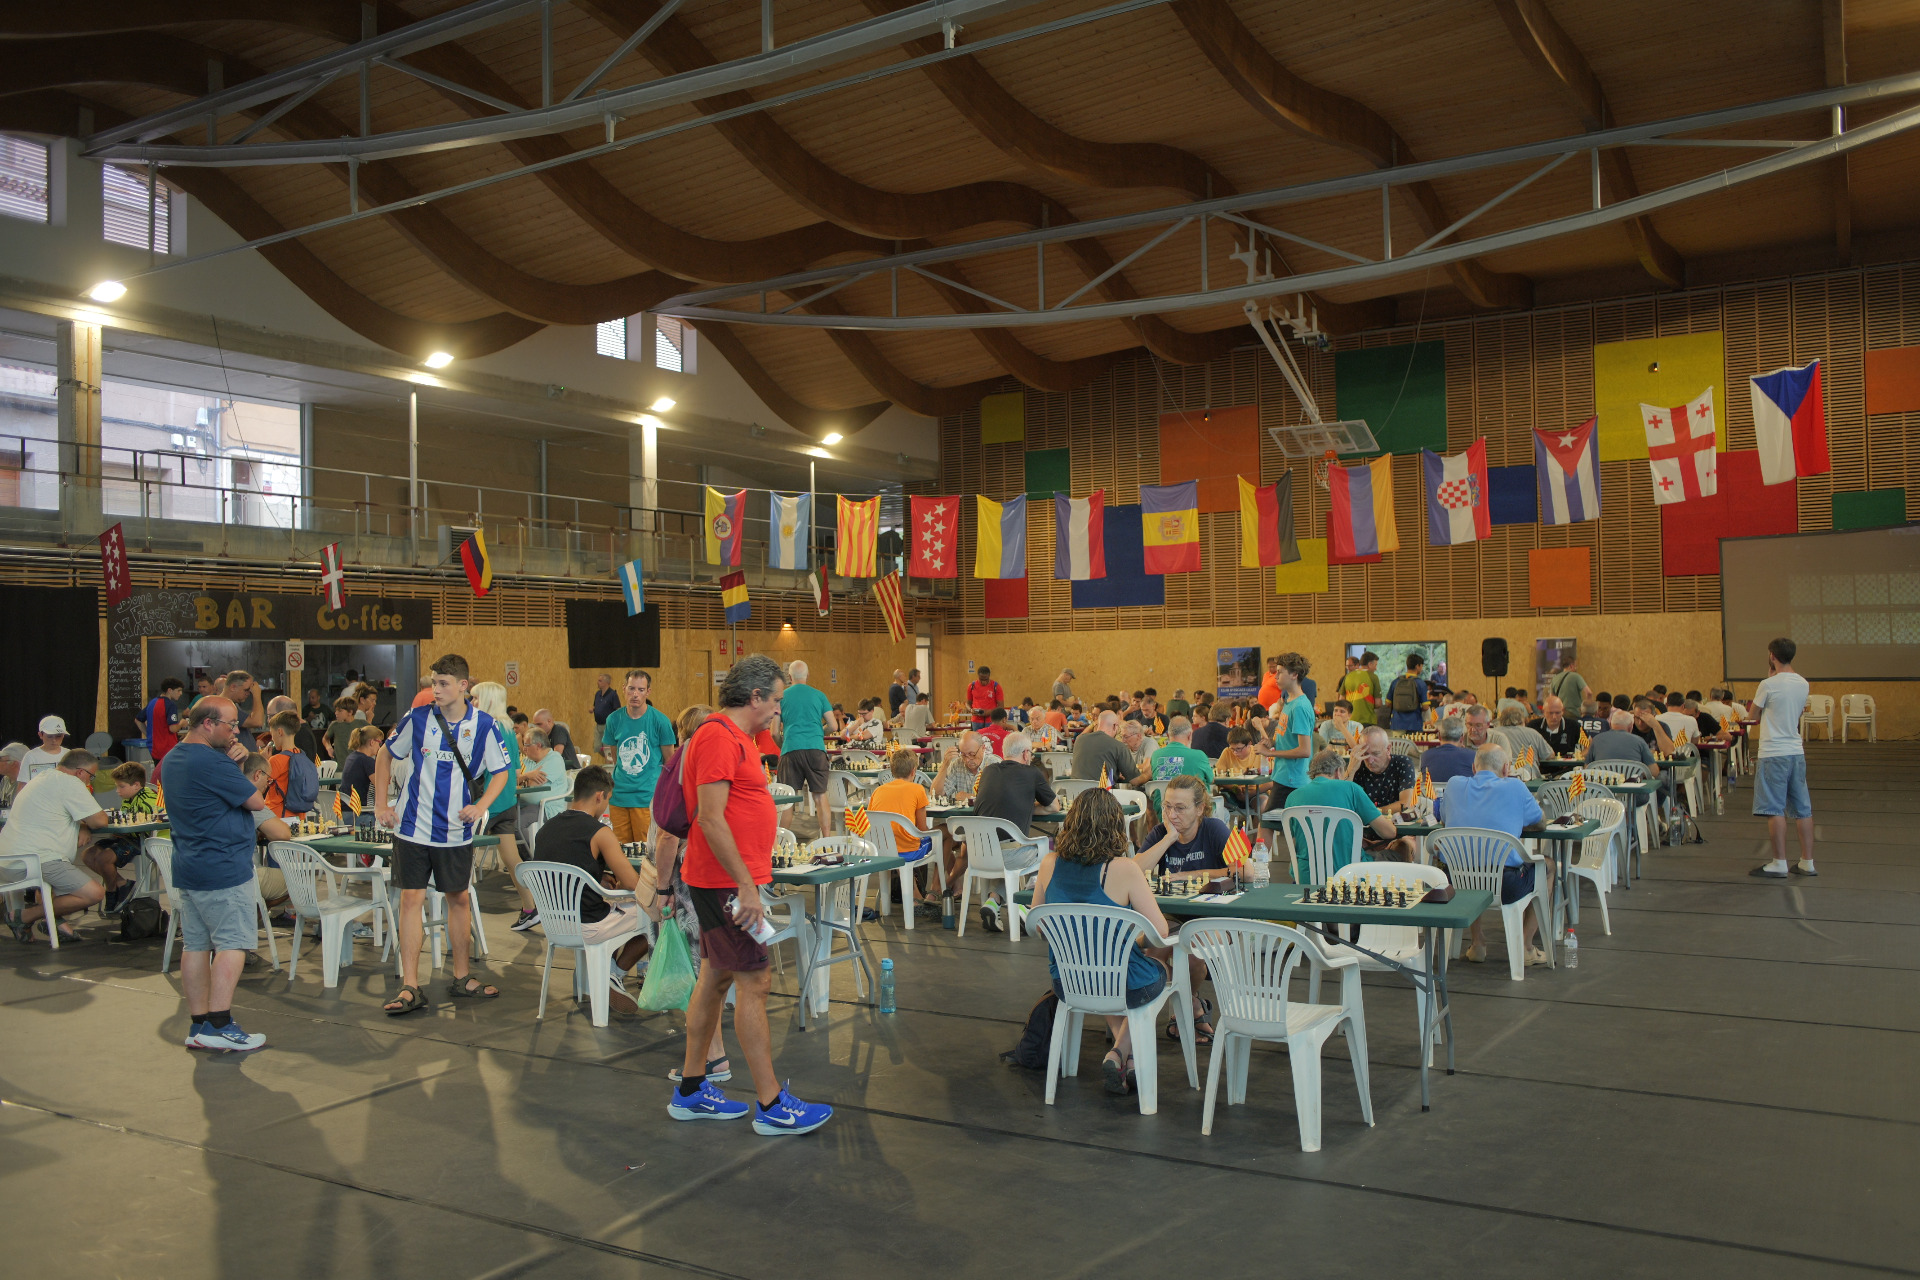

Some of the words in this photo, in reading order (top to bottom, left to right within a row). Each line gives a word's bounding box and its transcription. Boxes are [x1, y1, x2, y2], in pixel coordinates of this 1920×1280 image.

[194, 597, 276, 630] BAR
[316, 604, 403, 631] Co-ffee
[114, 617, 176, 640] MAJOR
[435, 750, 471, 761] YASA
